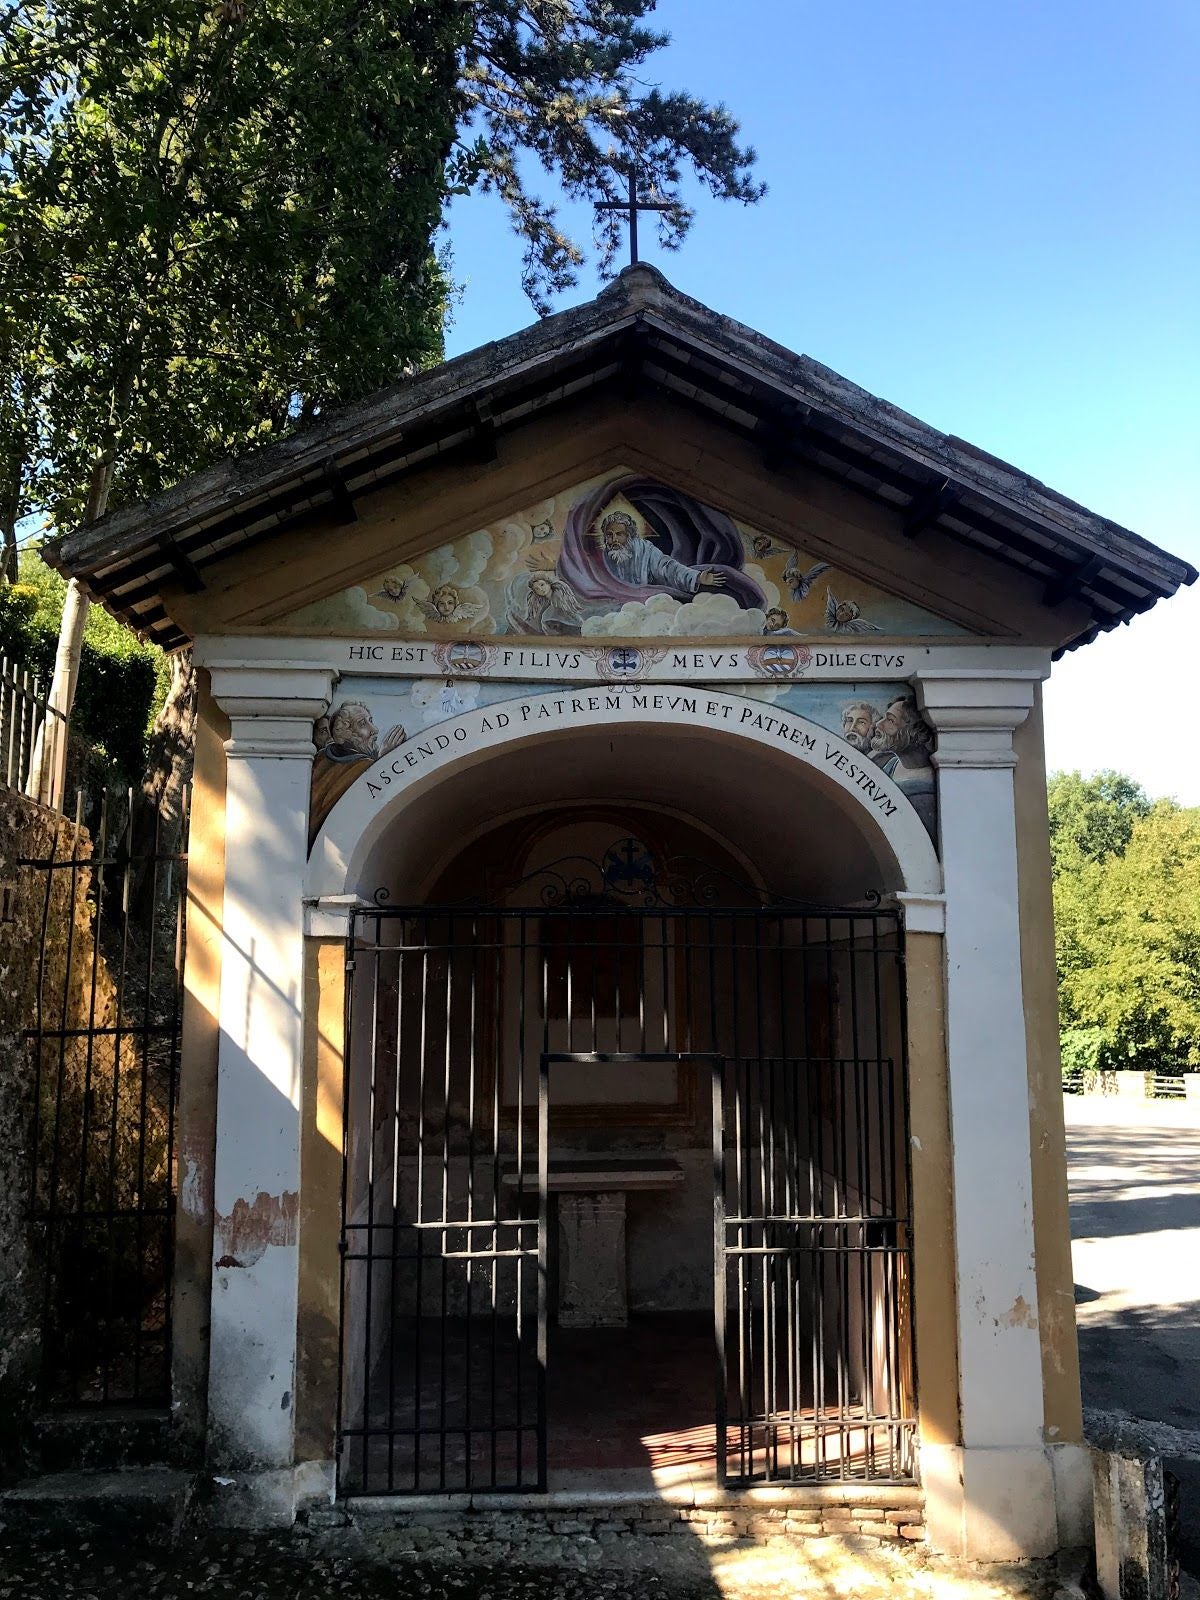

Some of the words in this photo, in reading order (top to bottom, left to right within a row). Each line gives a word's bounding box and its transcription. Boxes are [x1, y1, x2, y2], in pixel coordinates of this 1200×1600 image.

[349, 646, 384, 661] HIC
[391, 647, 428, 662] EST
[503, 651, 581, 669] FILIVS
[672, 654, 738, 668] MEVS
[815, 653, 905, 668] DILECTVS
[366, 727, 468, 799] ASCENDO
[480, 713, 510, 733] AD
[521, 696, 621, 721] PATREM
[632, 695, 697, 713] MEVM
[706, 701, 733, 718] ET
[739, 707, 816, 751] PATREM
[824, 743, 897, 817] VESTRVM
